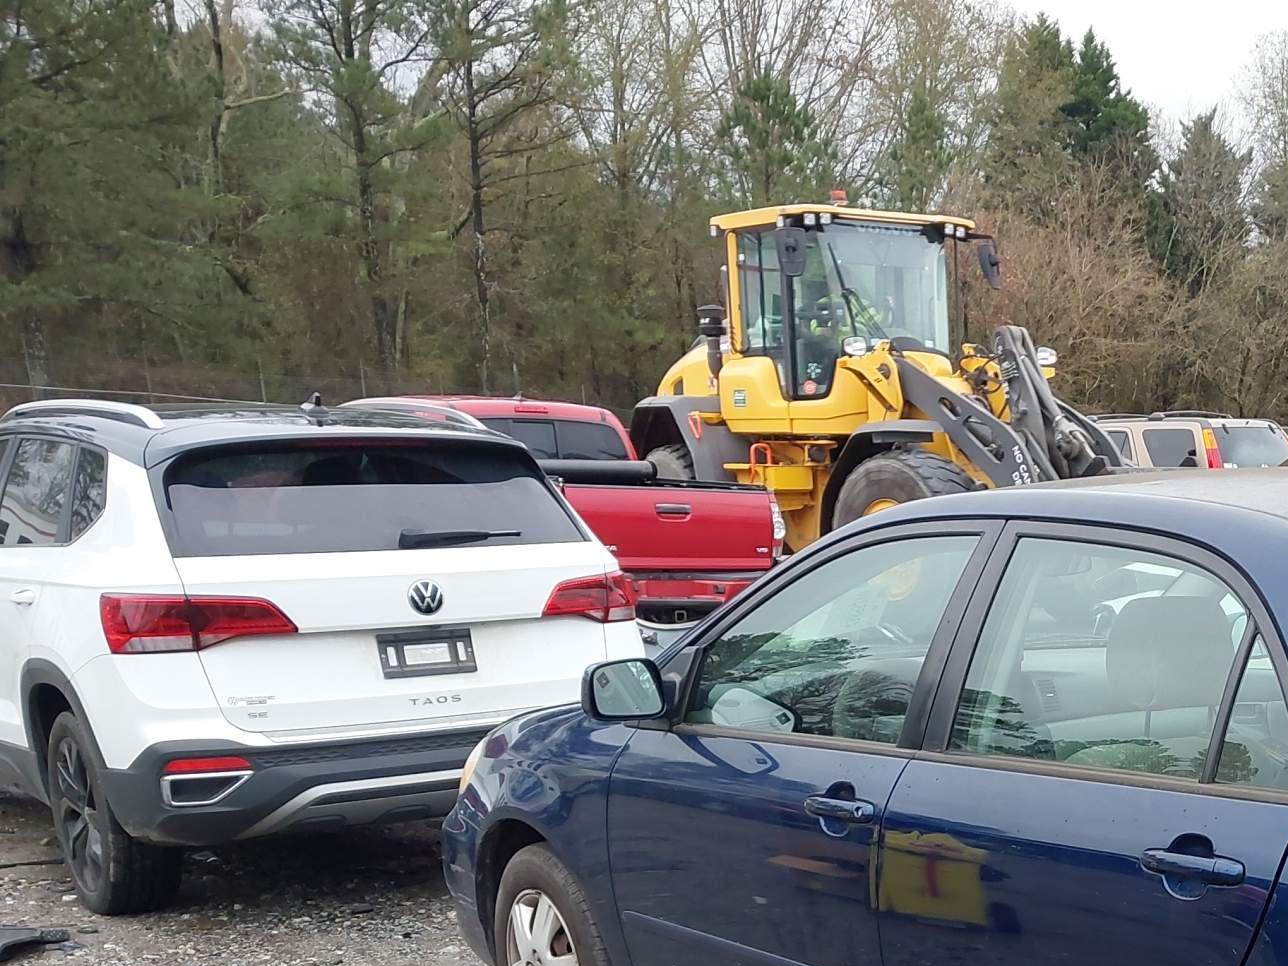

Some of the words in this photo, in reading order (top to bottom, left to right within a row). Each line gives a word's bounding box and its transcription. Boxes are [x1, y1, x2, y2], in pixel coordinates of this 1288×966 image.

[1012, 445, 1024, 463] NO
[408, 695, 462, 706] TAOS
[248, 711, 268, 719] SE
